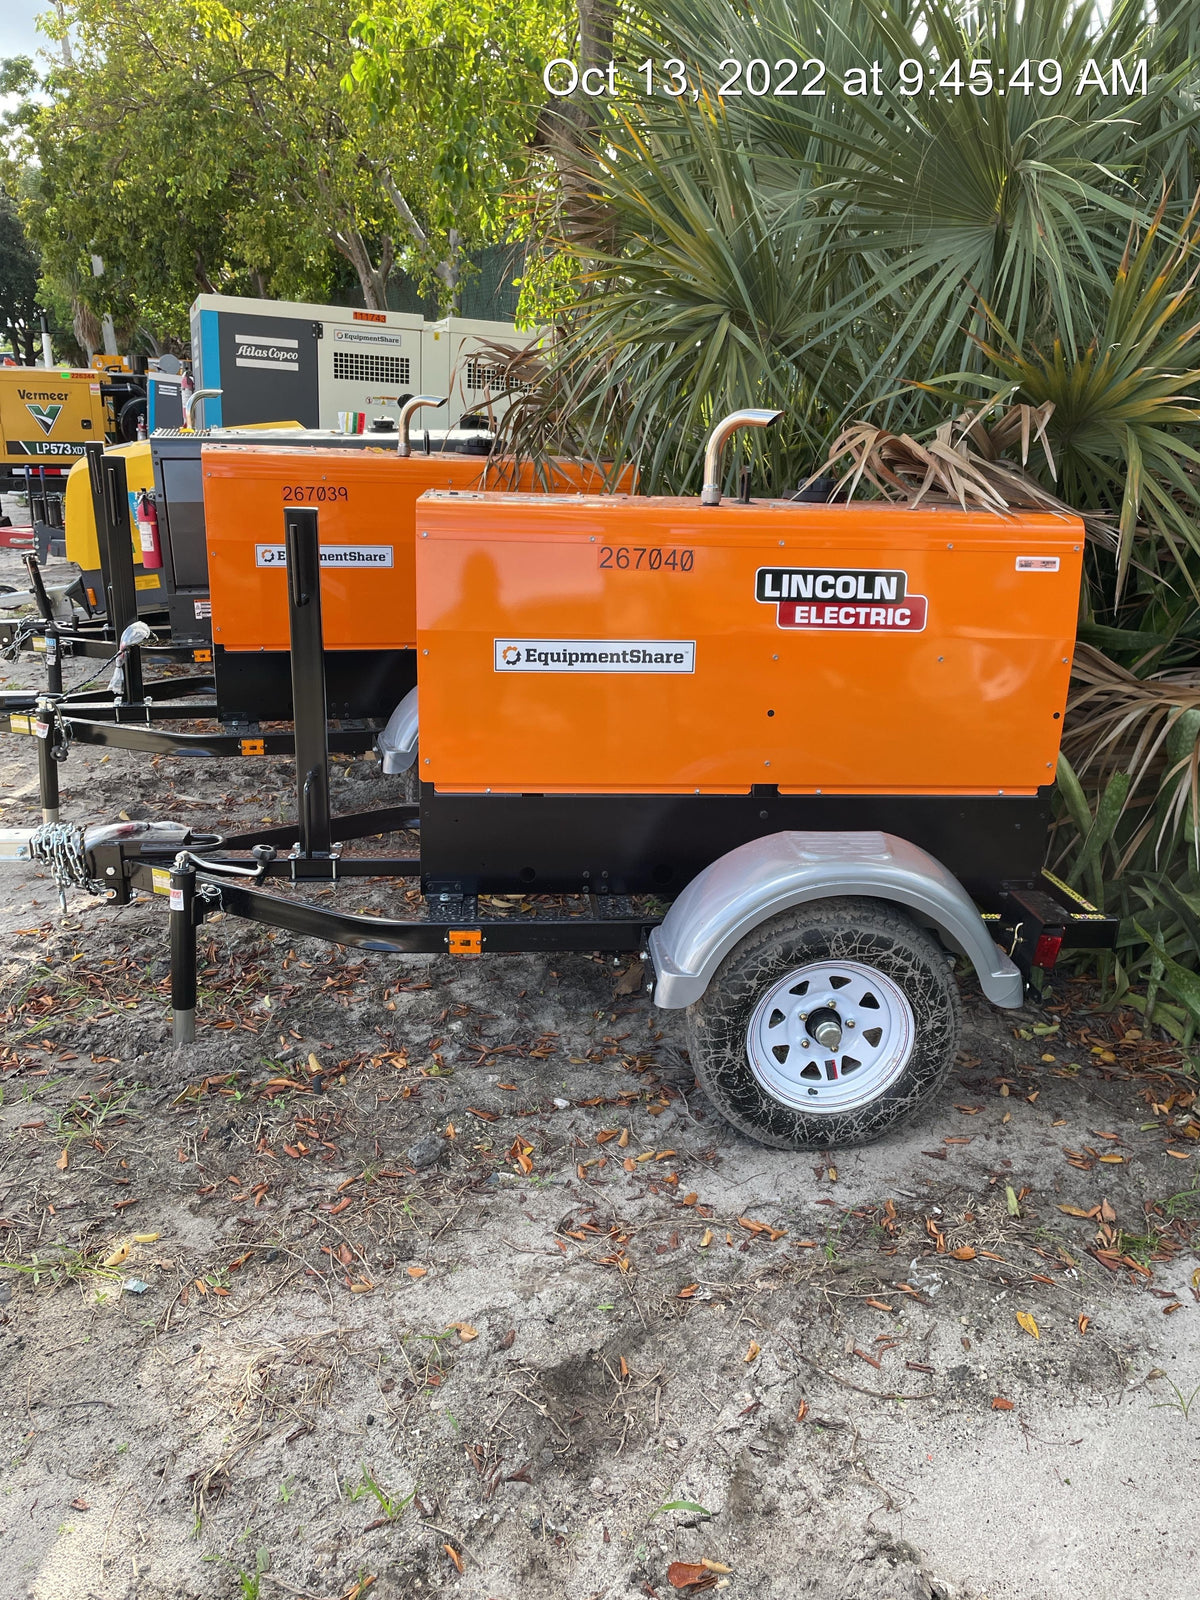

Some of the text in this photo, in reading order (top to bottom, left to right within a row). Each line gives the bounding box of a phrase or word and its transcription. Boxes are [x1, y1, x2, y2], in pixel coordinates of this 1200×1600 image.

[353, 311, 386, 323] 111743
[344, 333, 399, 344] EquipmentShare
[236, 345, 298, 360] Atlas Copco
[17, 389, 69, 401] Vermeer
[283, 486, 348, 502] 267039
[277, 550, 386, 562] EmentShare
[599, 546, 694, 572] 267040
[764, 573, 897, 600] LINCOLN
[794, 605, 911, 626] ELECTRIC
[525, 648, 684, 666] EquipmentShare
